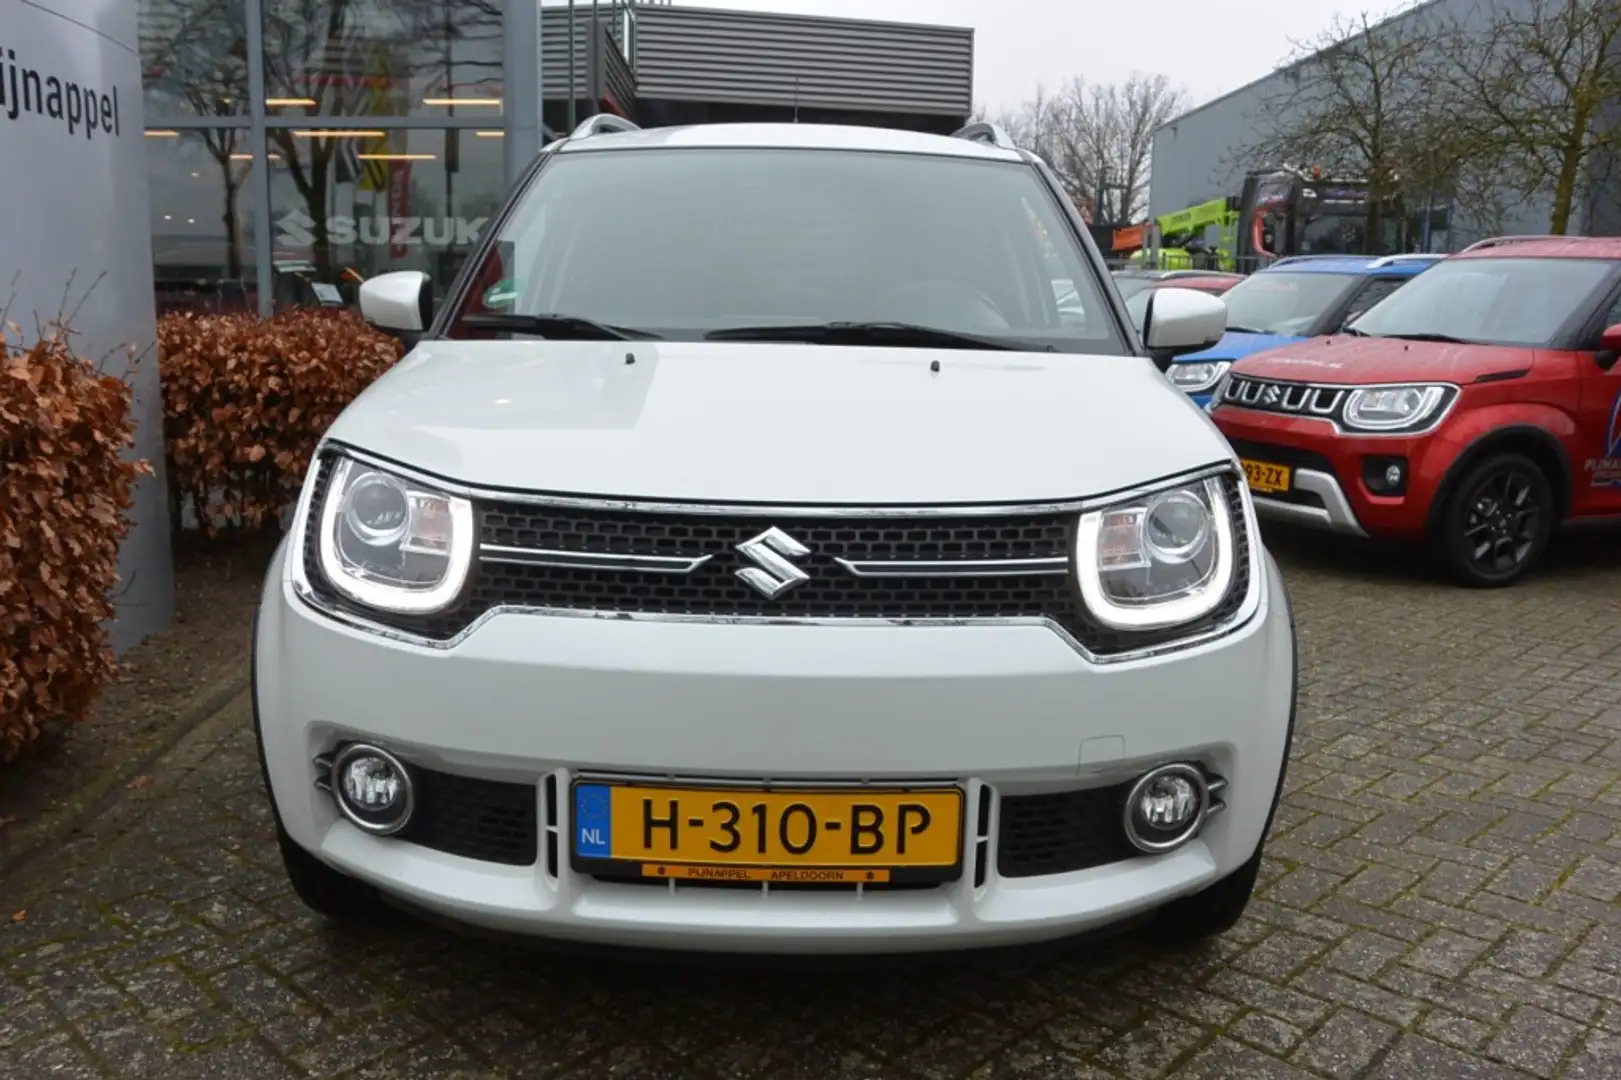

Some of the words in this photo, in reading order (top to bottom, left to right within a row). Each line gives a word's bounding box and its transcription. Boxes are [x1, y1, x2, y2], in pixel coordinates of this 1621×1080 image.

[326, 216, 489, 245] SUZUK
[1241, 462, 1284, 487] 93-ZX
[582, 827, 606, 846] NL
[642, 798, 932, 856] H-310-BP
[771, 871, 844, 882] APELDOORN
